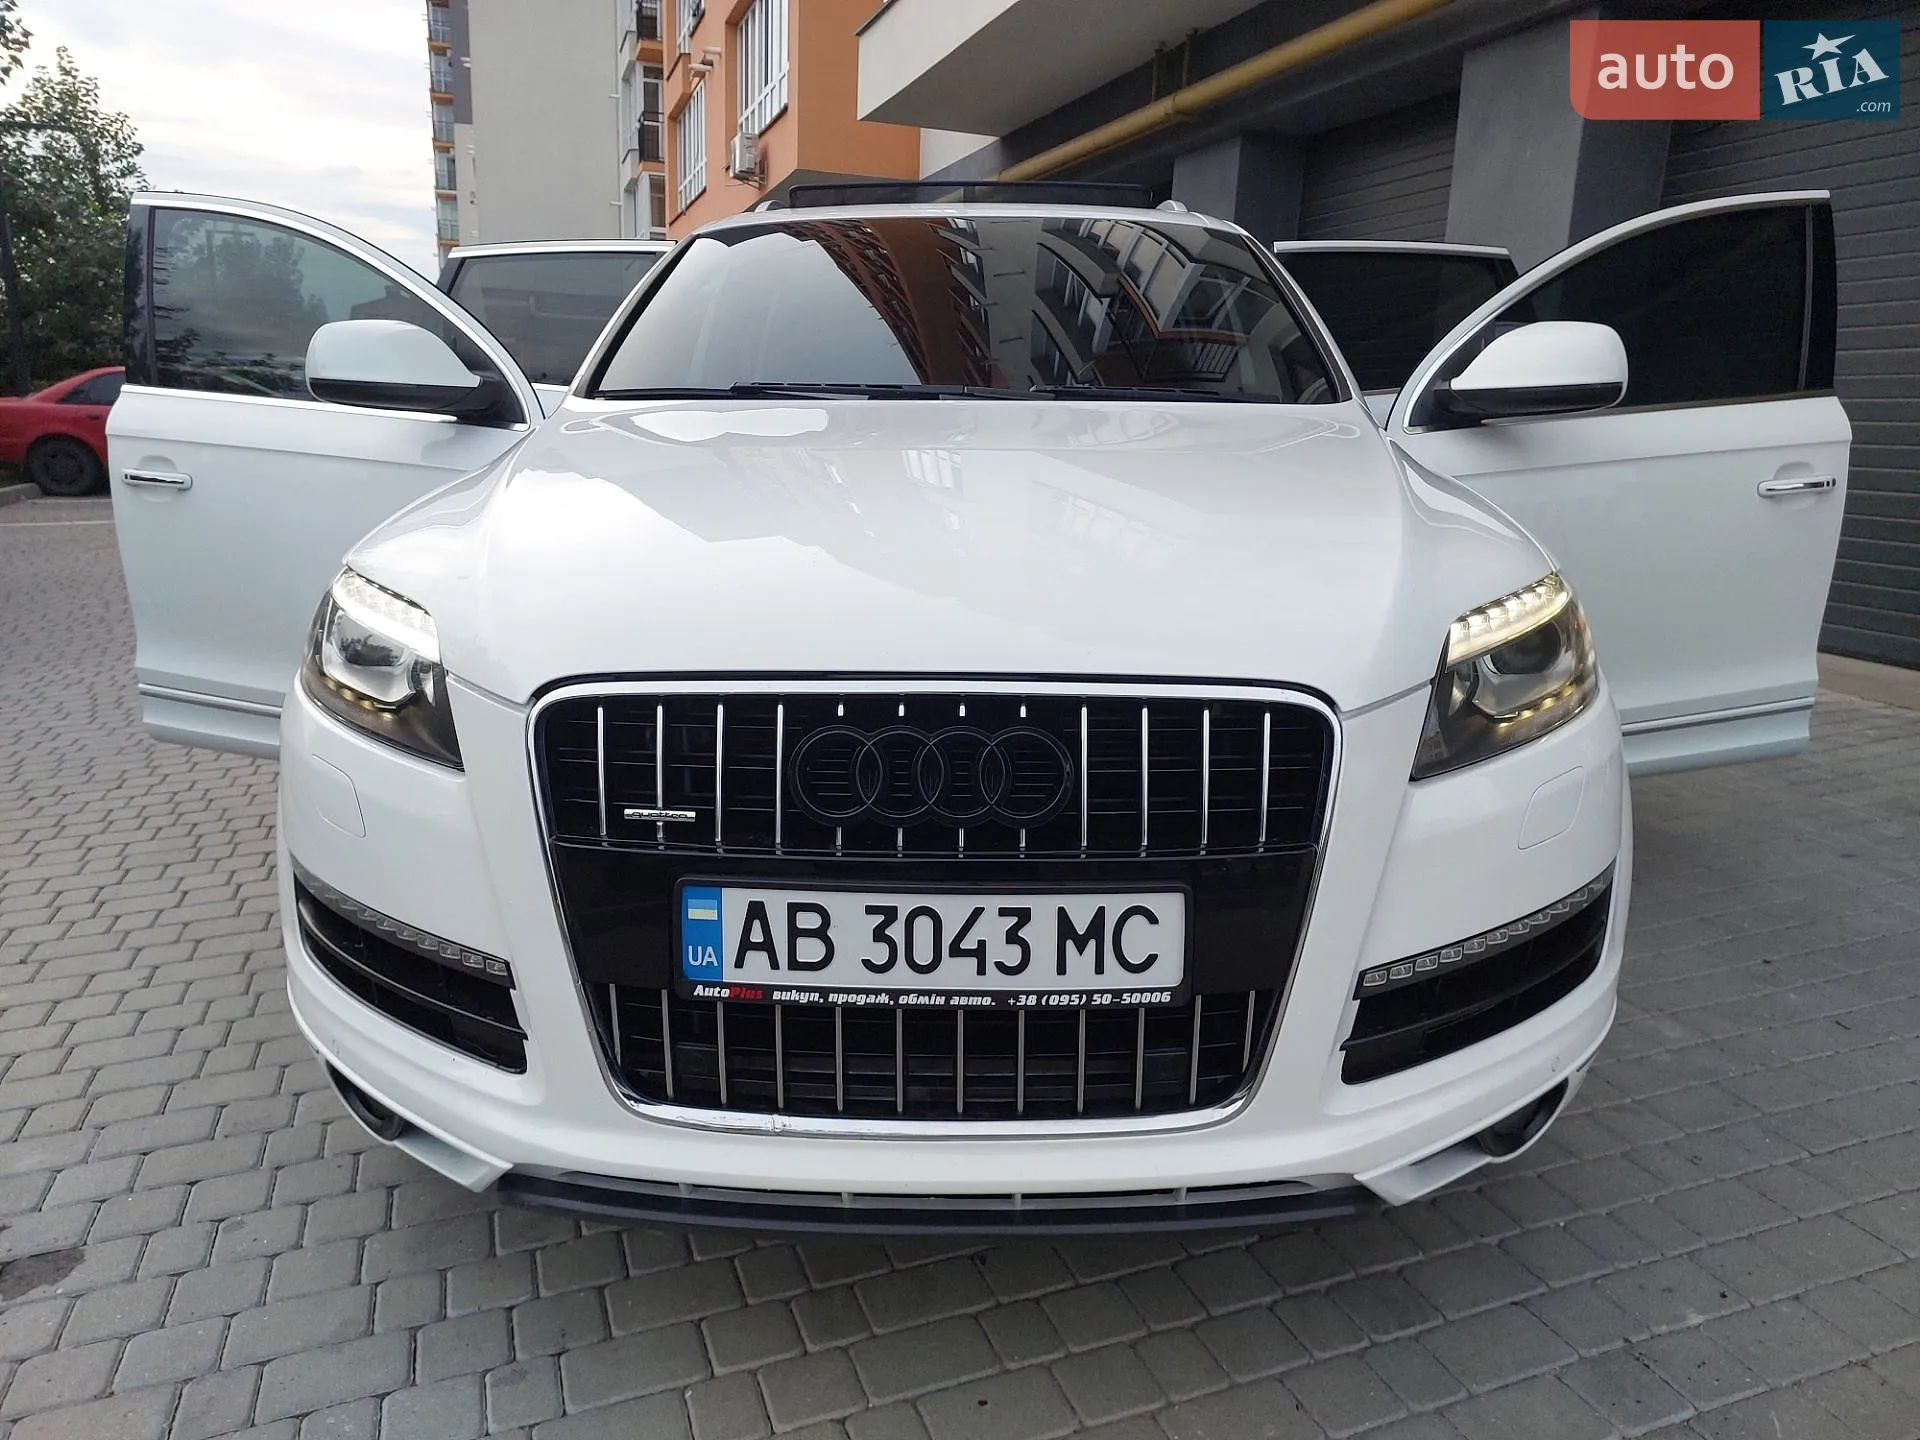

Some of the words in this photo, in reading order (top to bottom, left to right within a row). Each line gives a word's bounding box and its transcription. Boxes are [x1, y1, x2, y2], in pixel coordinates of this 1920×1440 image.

[733, 900, 836, 972] AB
[860, 904, 1033, 976] 3043
[1055, 904, 1161, 976] MC
[688, 945, 719, 967] UA
[693, 984, 765, 1000] AutoPlus
[828, 992, 895, 1006] продаж,
[898, 993, 946, 1006] обмін
[950, 995, 997, 1006] авто.
[1007, 994, 1038, 1006] +38
[1041, 994, 1087, 1006] (095)
[1091, 991, 1172, 1005] 50-50006
